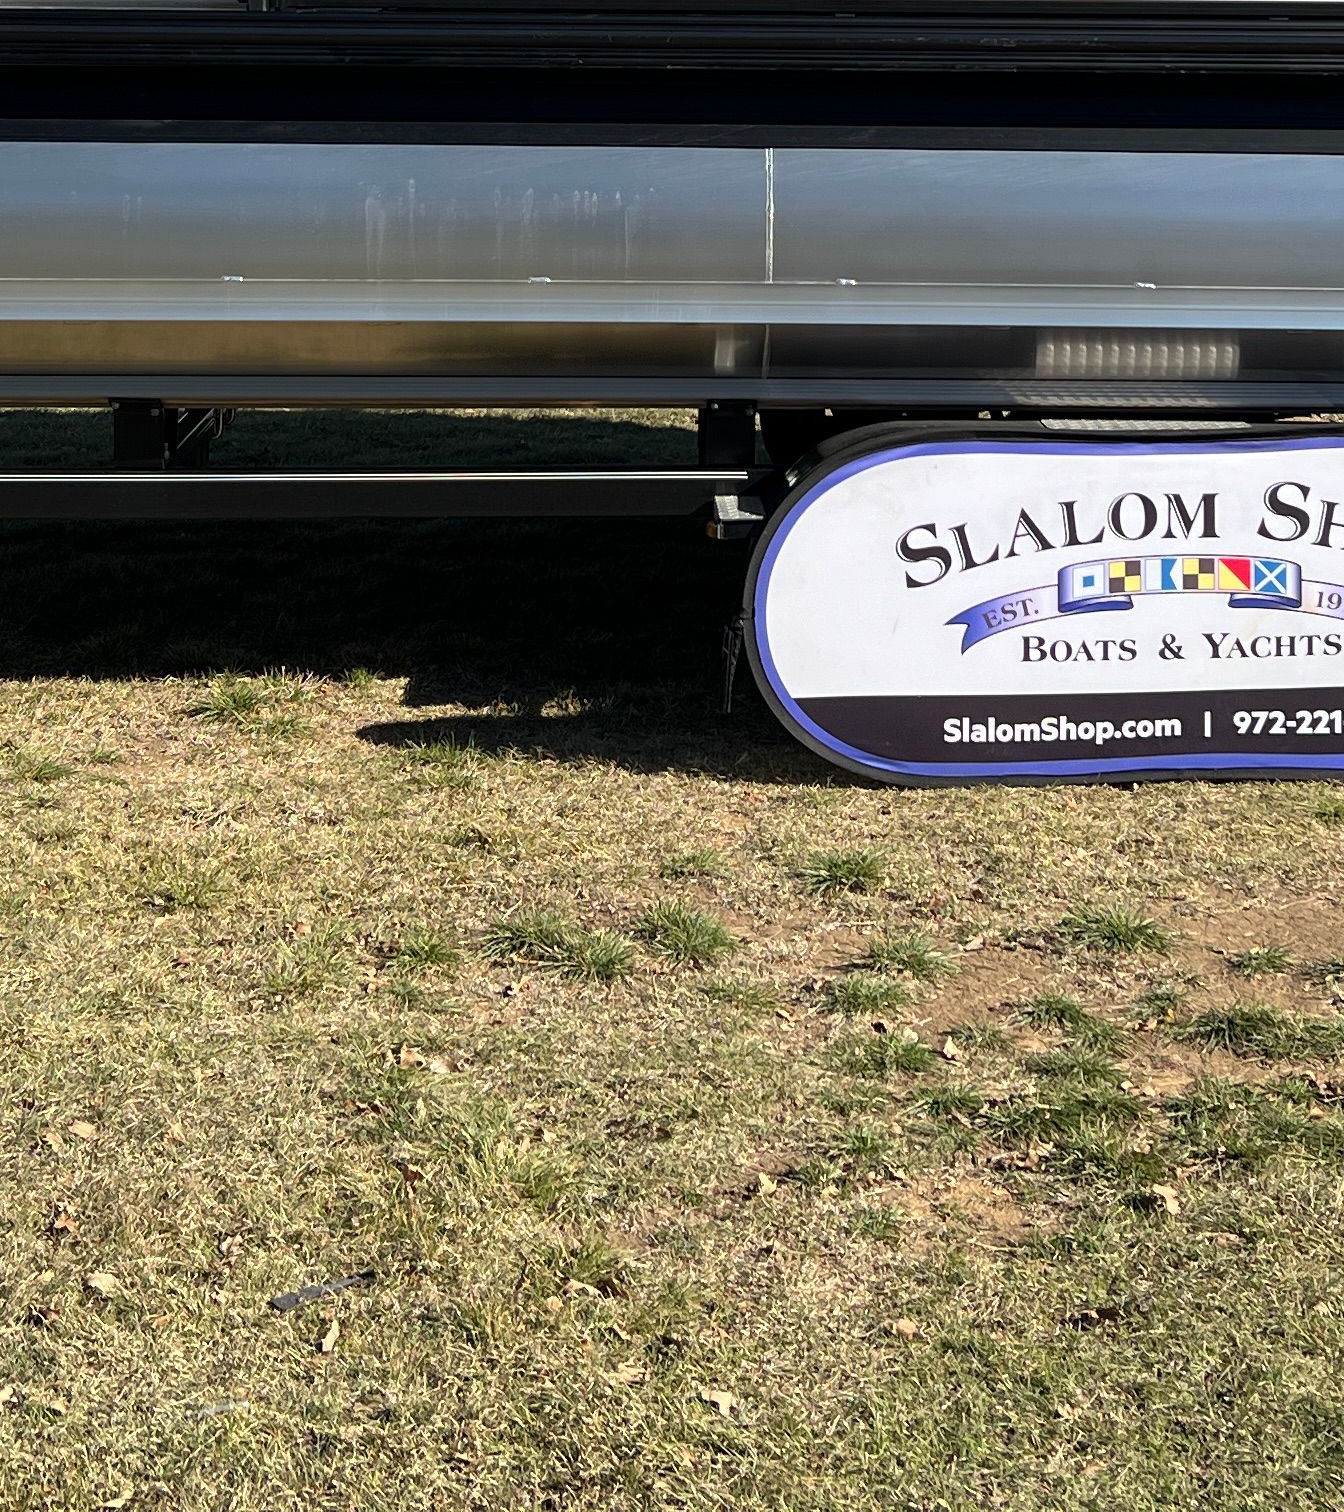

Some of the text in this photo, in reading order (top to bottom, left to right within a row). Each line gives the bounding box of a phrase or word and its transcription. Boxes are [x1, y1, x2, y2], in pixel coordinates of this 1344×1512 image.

[896, 492, 1221, 589] SLALOM
[982, 598, 1039, 629] EST.
[1021, 633, 1343, 662] BOATS & YACHTS
[943, 716, 1183, 745] SlalomShop.com
